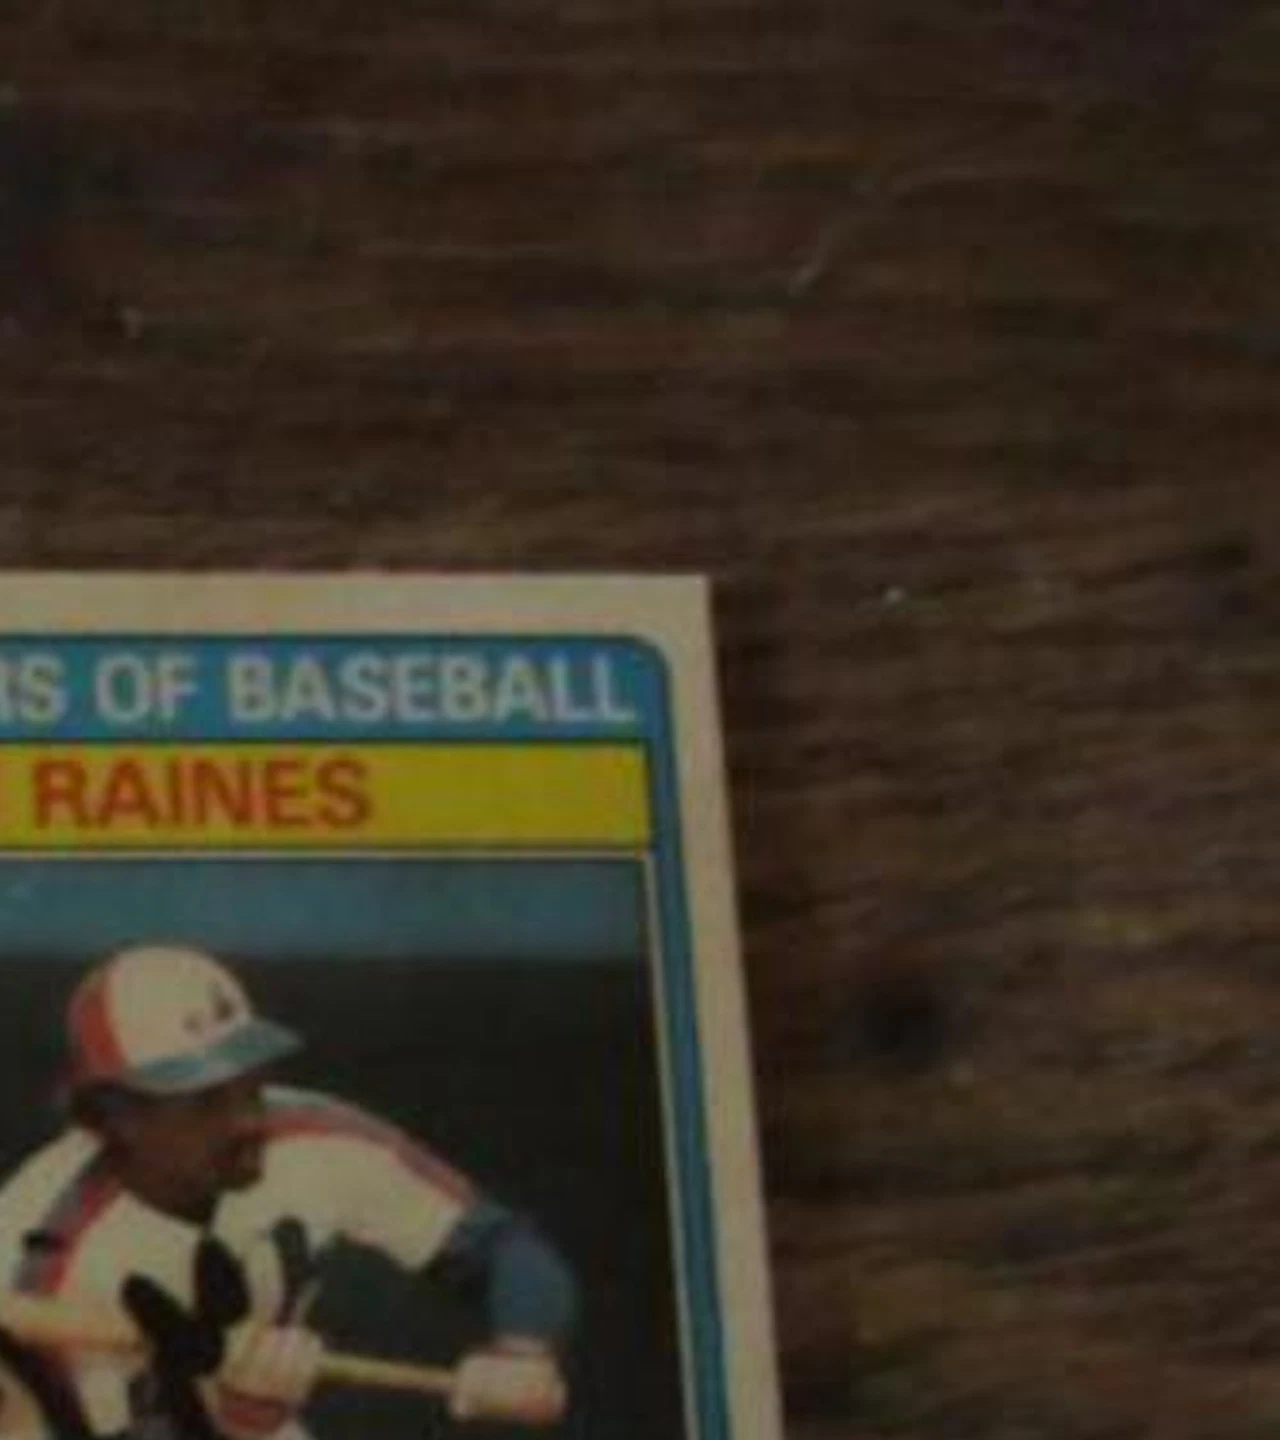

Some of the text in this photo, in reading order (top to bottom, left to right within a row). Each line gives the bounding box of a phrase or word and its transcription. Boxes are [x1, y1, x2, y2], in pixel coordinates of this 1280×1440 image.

[95, 655, 198, 724] OF
[227, 653, 636, 726] BASEBALL
[30, 758, 374, 828] RAINES
